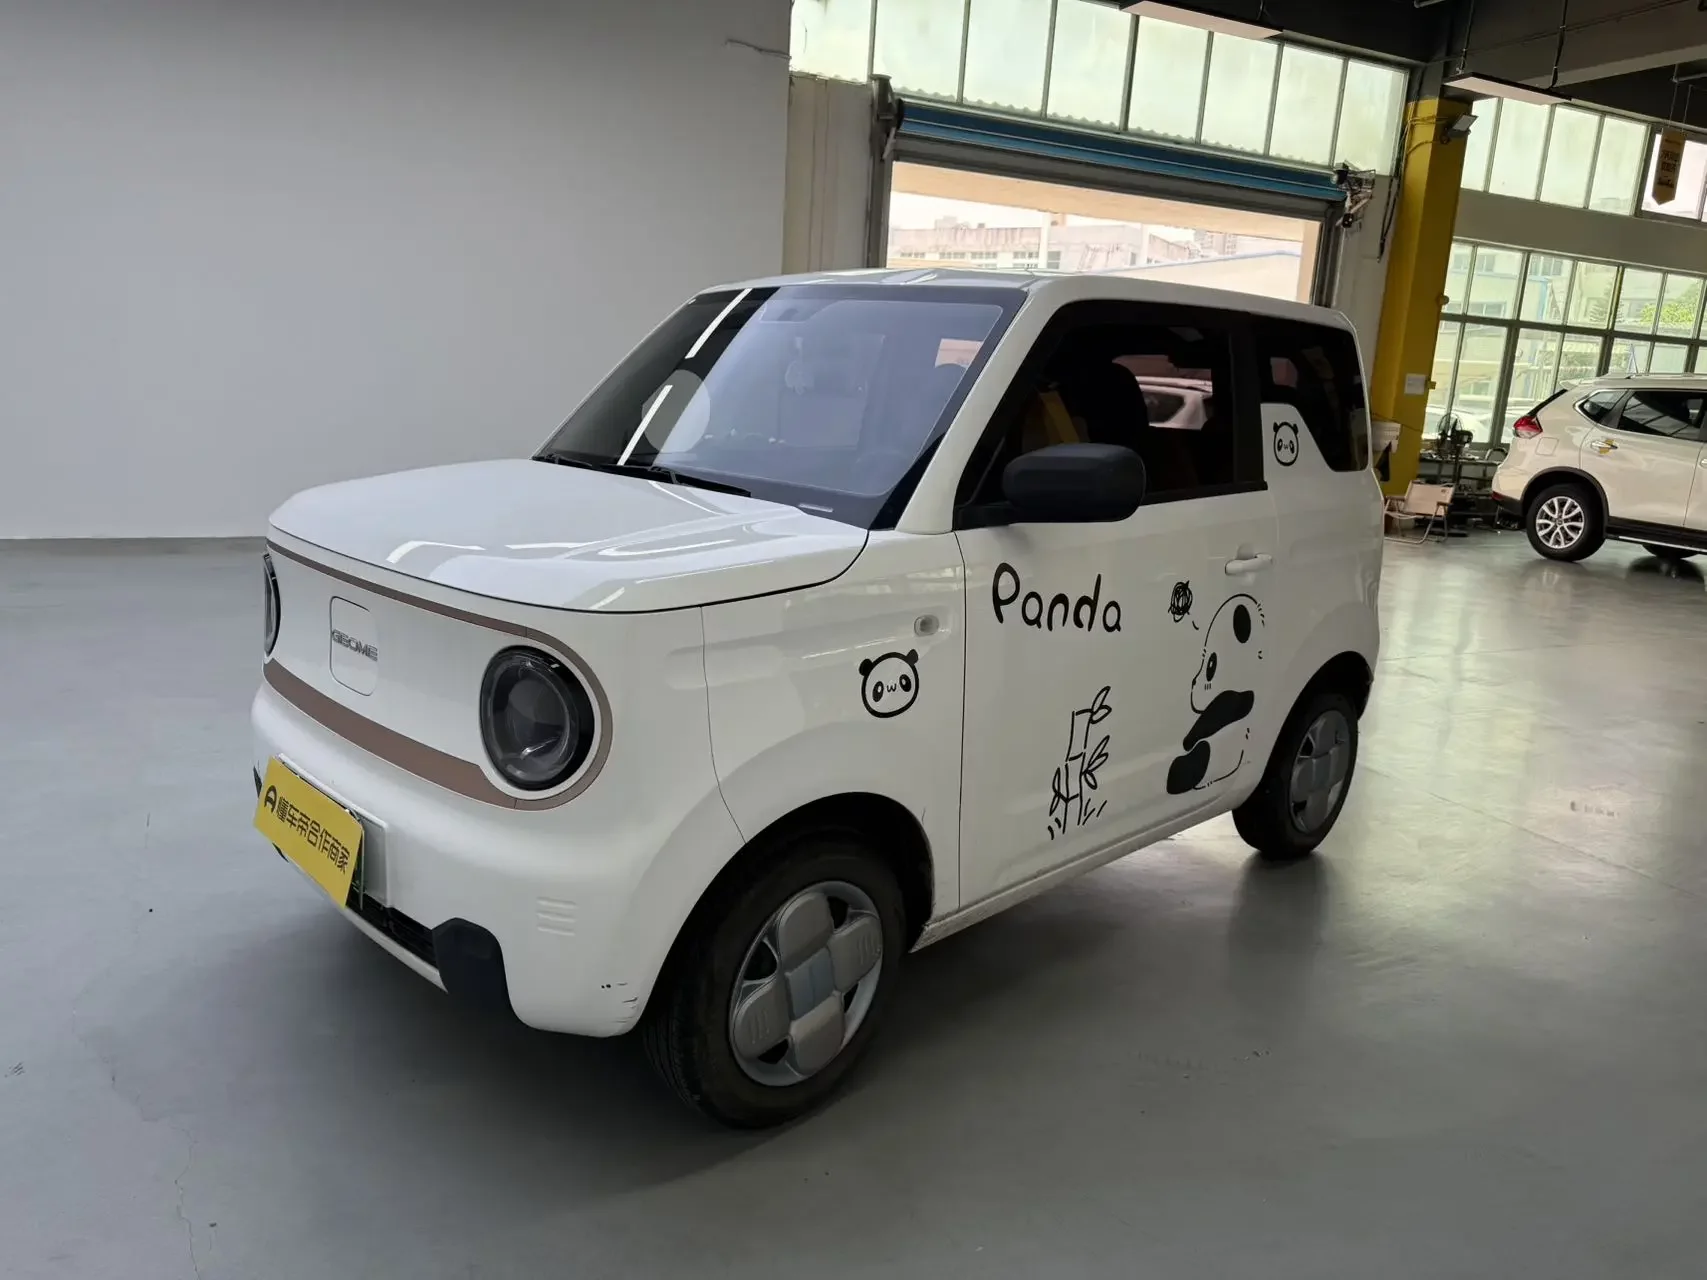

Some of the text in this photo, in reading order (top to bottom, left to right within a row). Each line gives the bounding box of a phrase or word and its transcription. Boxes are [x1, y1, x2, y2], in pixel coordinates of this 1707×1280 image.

[992, 562, 1121, 633] Panda
[277, 796, 351, 875] 懂车帝合作商家
